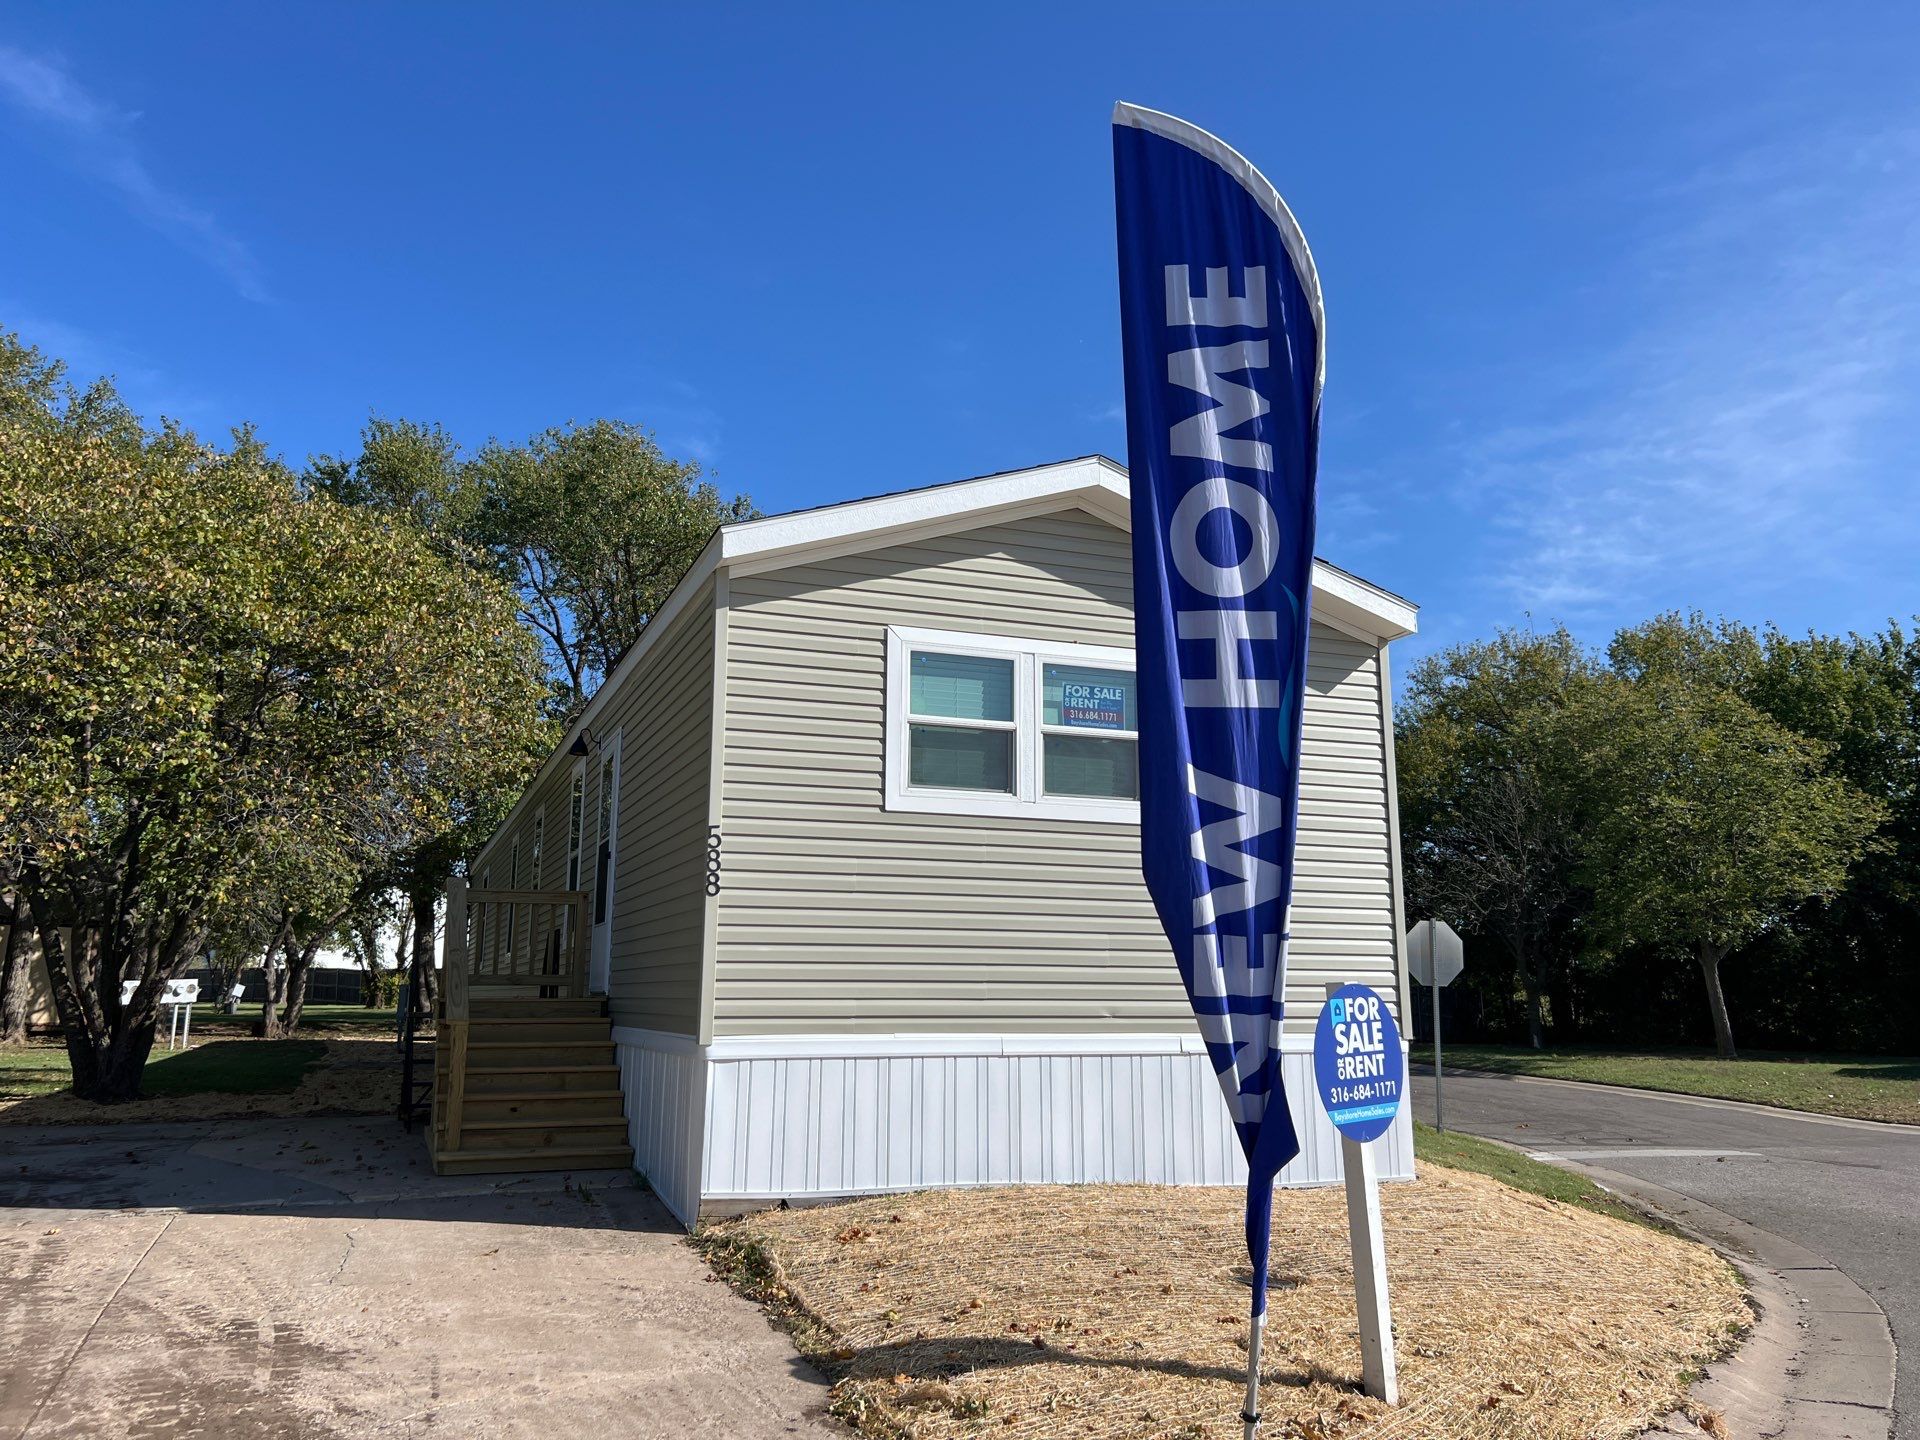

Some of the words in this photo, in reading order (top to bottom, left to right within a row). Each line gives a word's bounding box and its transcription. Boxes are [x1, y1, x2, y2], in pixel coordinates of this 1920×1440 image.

[1164, 263, 1280, 709] HOME
[1065, 685, 1090, 698] FOR
[1093, 687, 1122, 700] SALE
[1070, 697, 1100, 709] RENT
[1069, 709, 1117, 721] 316.684.1171
[705, 825, 722, 897] 588
[1186, 762, 1283, 1125] NEW
[1344, 996, 1381, 1022] FOR
[1334, 1022, 1384, 1056] SALE
[1337, 1058, 1346, 1080] OR
[1345, 1053, 1385, 1080] RENT
[1330, 1080, 1396, 1104] 316-684-1171
